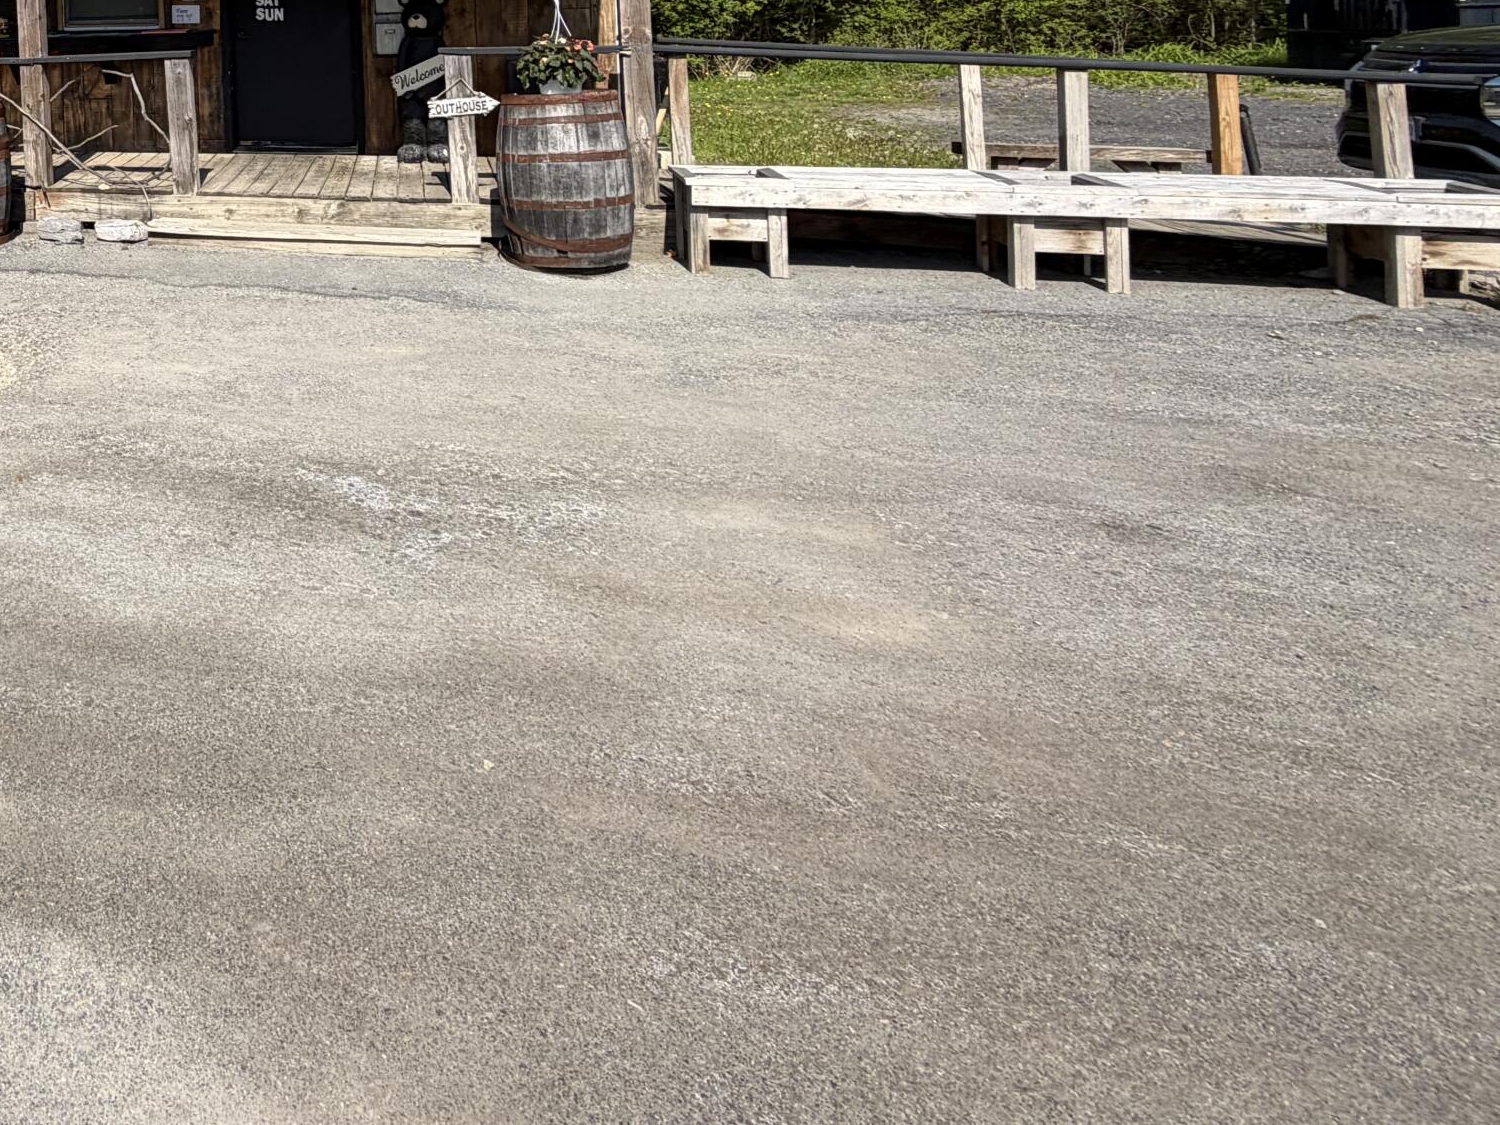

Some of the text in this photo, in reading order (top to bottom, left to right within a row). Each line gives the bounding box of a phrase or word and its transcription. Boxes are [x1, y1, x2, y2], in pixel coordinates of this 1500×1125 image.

[255, 8, 284, 21] SUN
[394, 62, 445, 90] Welcome
[435, 100, 488, 114] OUTHOUSE
